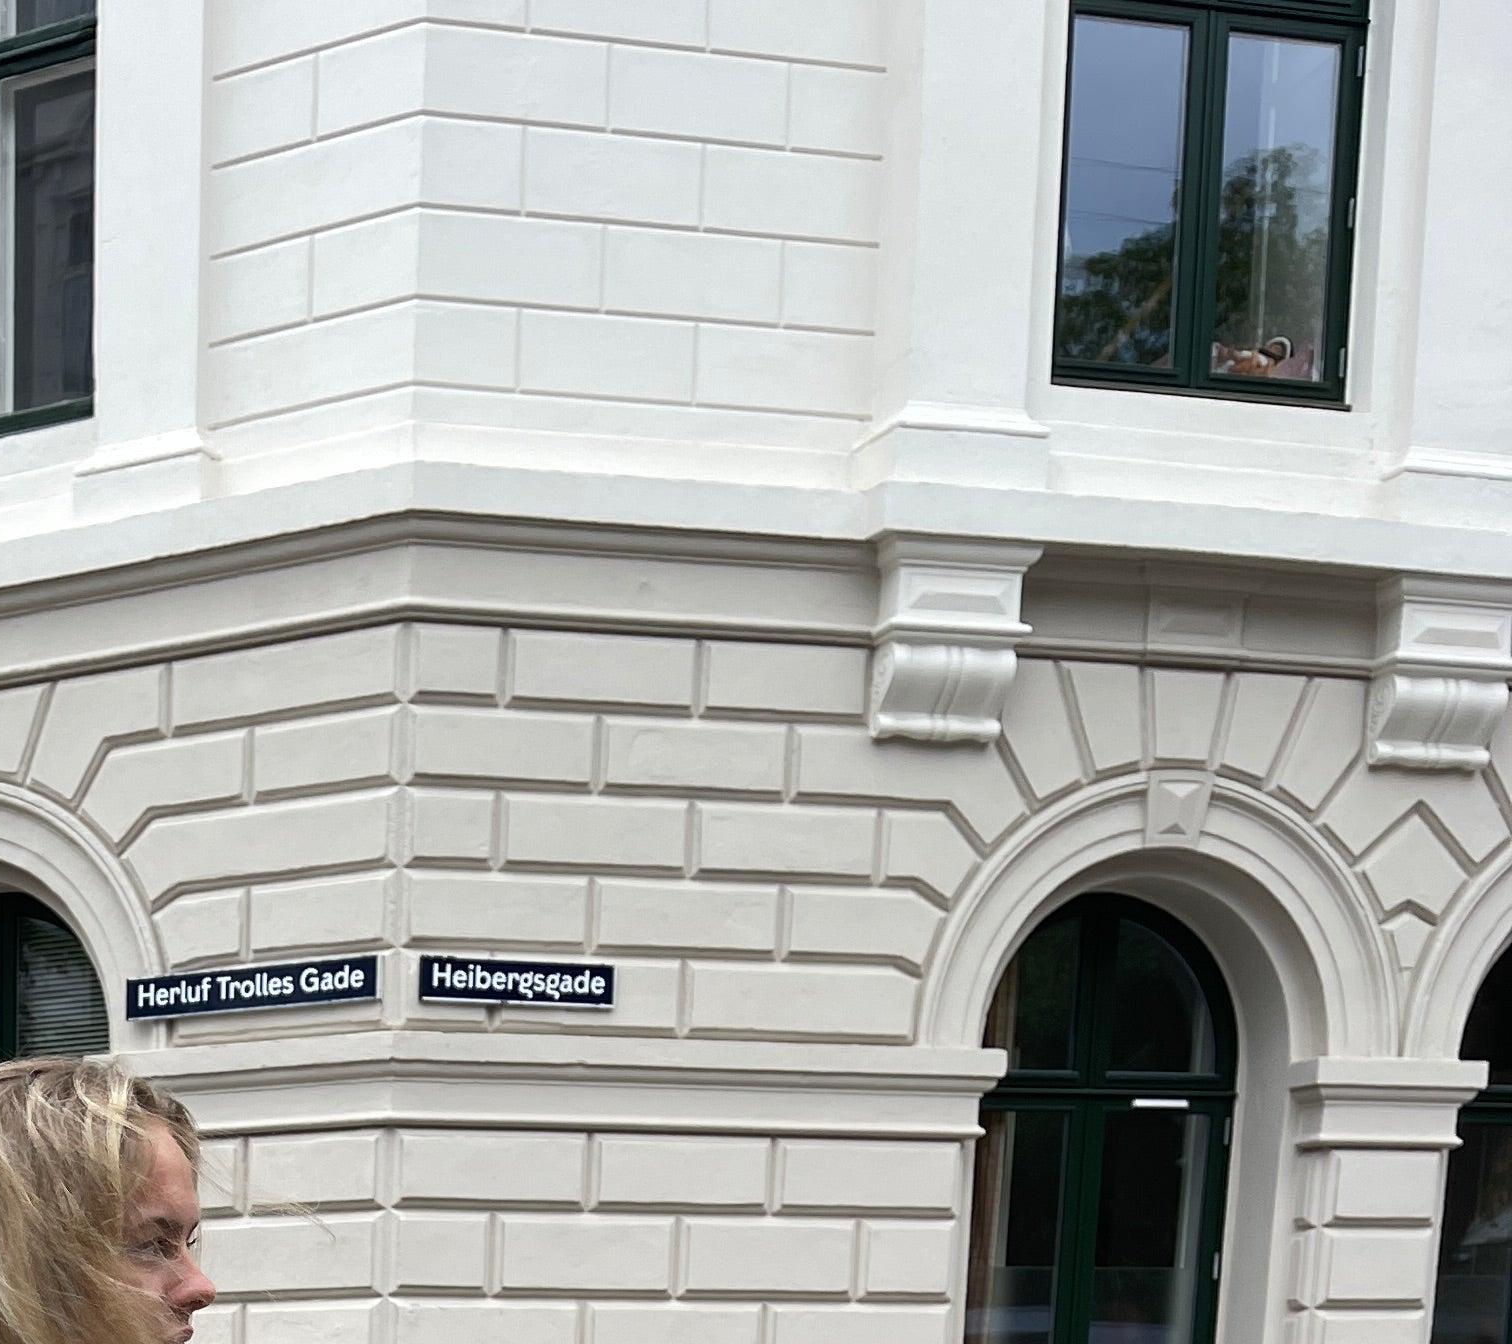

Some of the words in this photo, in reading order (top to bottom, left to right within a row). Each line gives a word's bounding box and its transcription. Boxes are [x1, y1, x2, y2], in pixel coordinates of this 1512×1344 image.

[137, 976, 212, 1008] Herluf
[215, 972, 294, 1000] Trolles
[299, 964, 365, 993] Gade
[431, 962, 606, 1000] Heibergsgade
